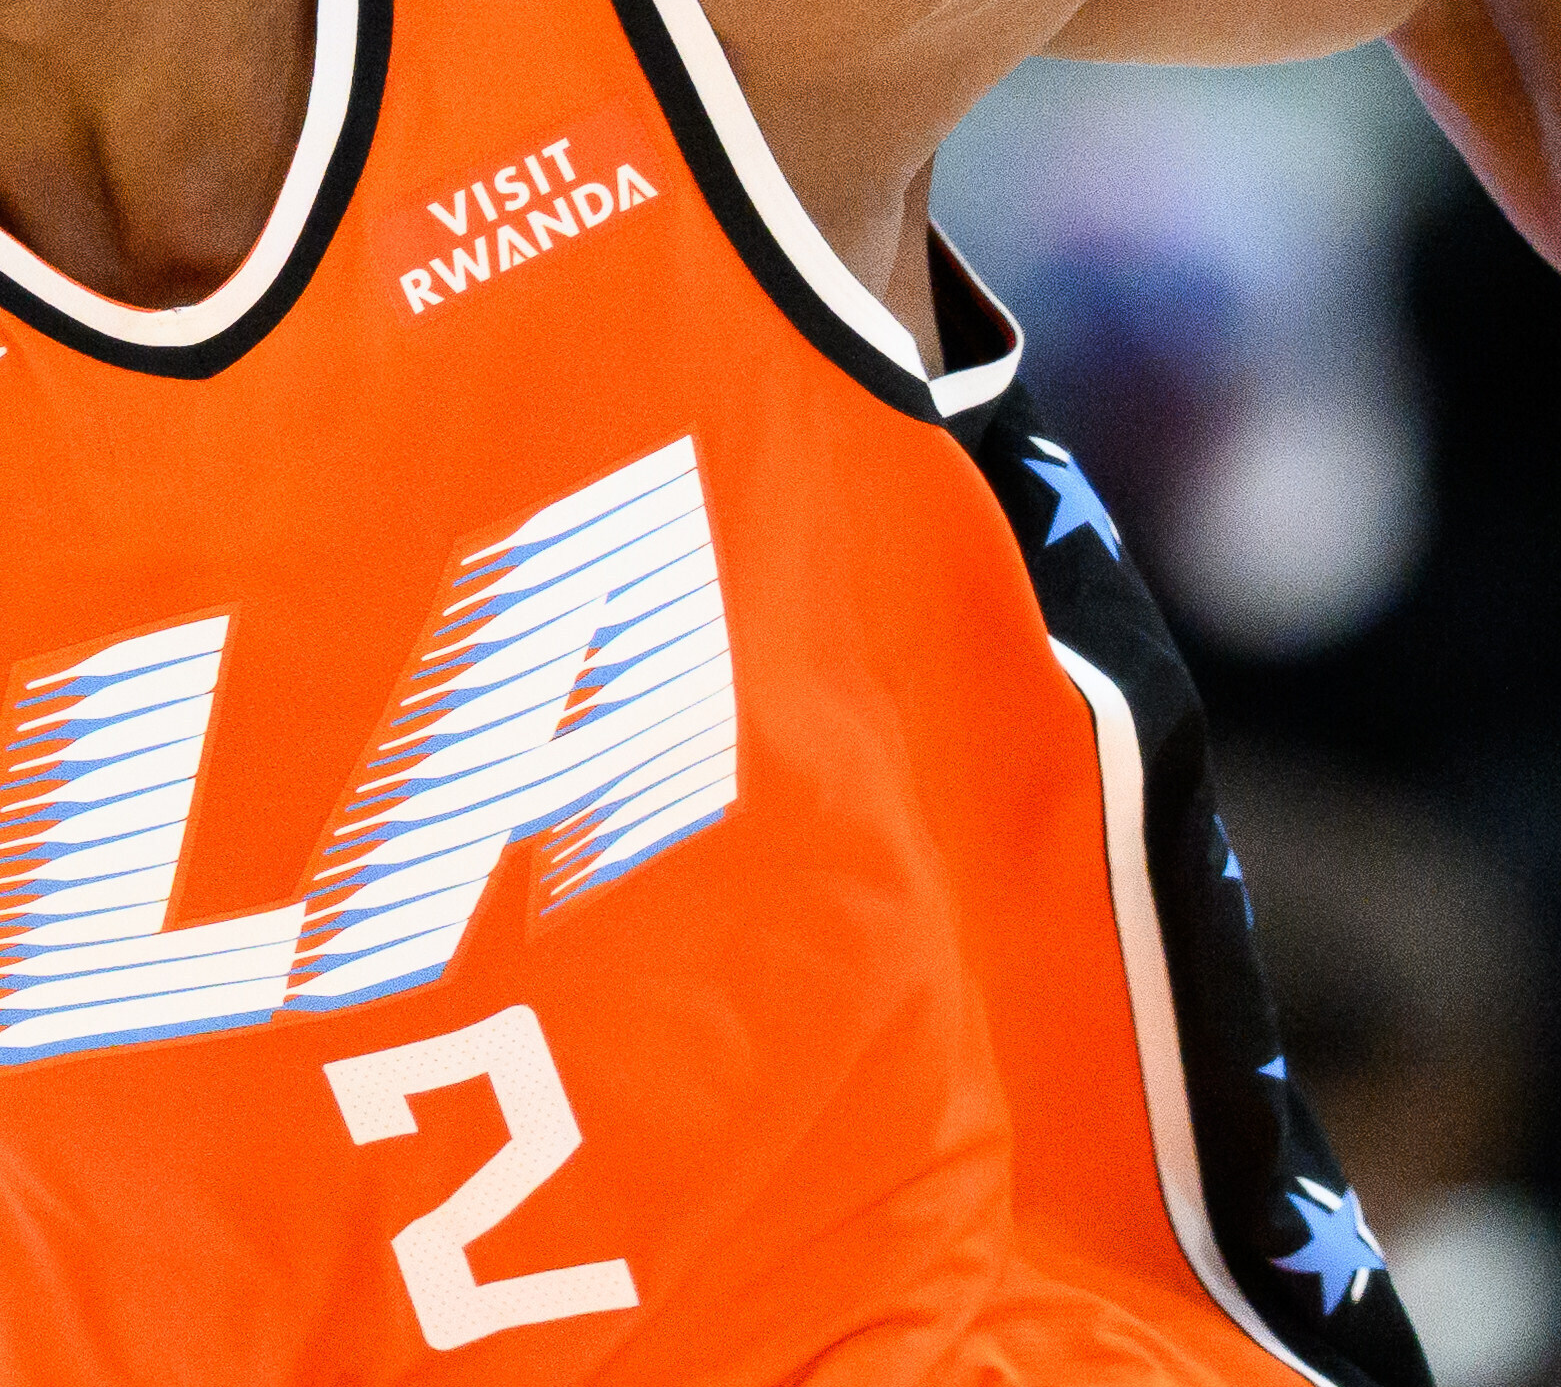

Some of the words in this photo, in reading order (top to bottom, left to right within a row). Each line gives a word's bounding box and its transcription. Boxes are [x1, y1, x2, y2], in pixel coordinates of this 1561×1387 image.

[399, 163, 658, 314] RWANDA
[427, 137, 575, 236] VISIT
[323, 1004, 640, 1351] 2
